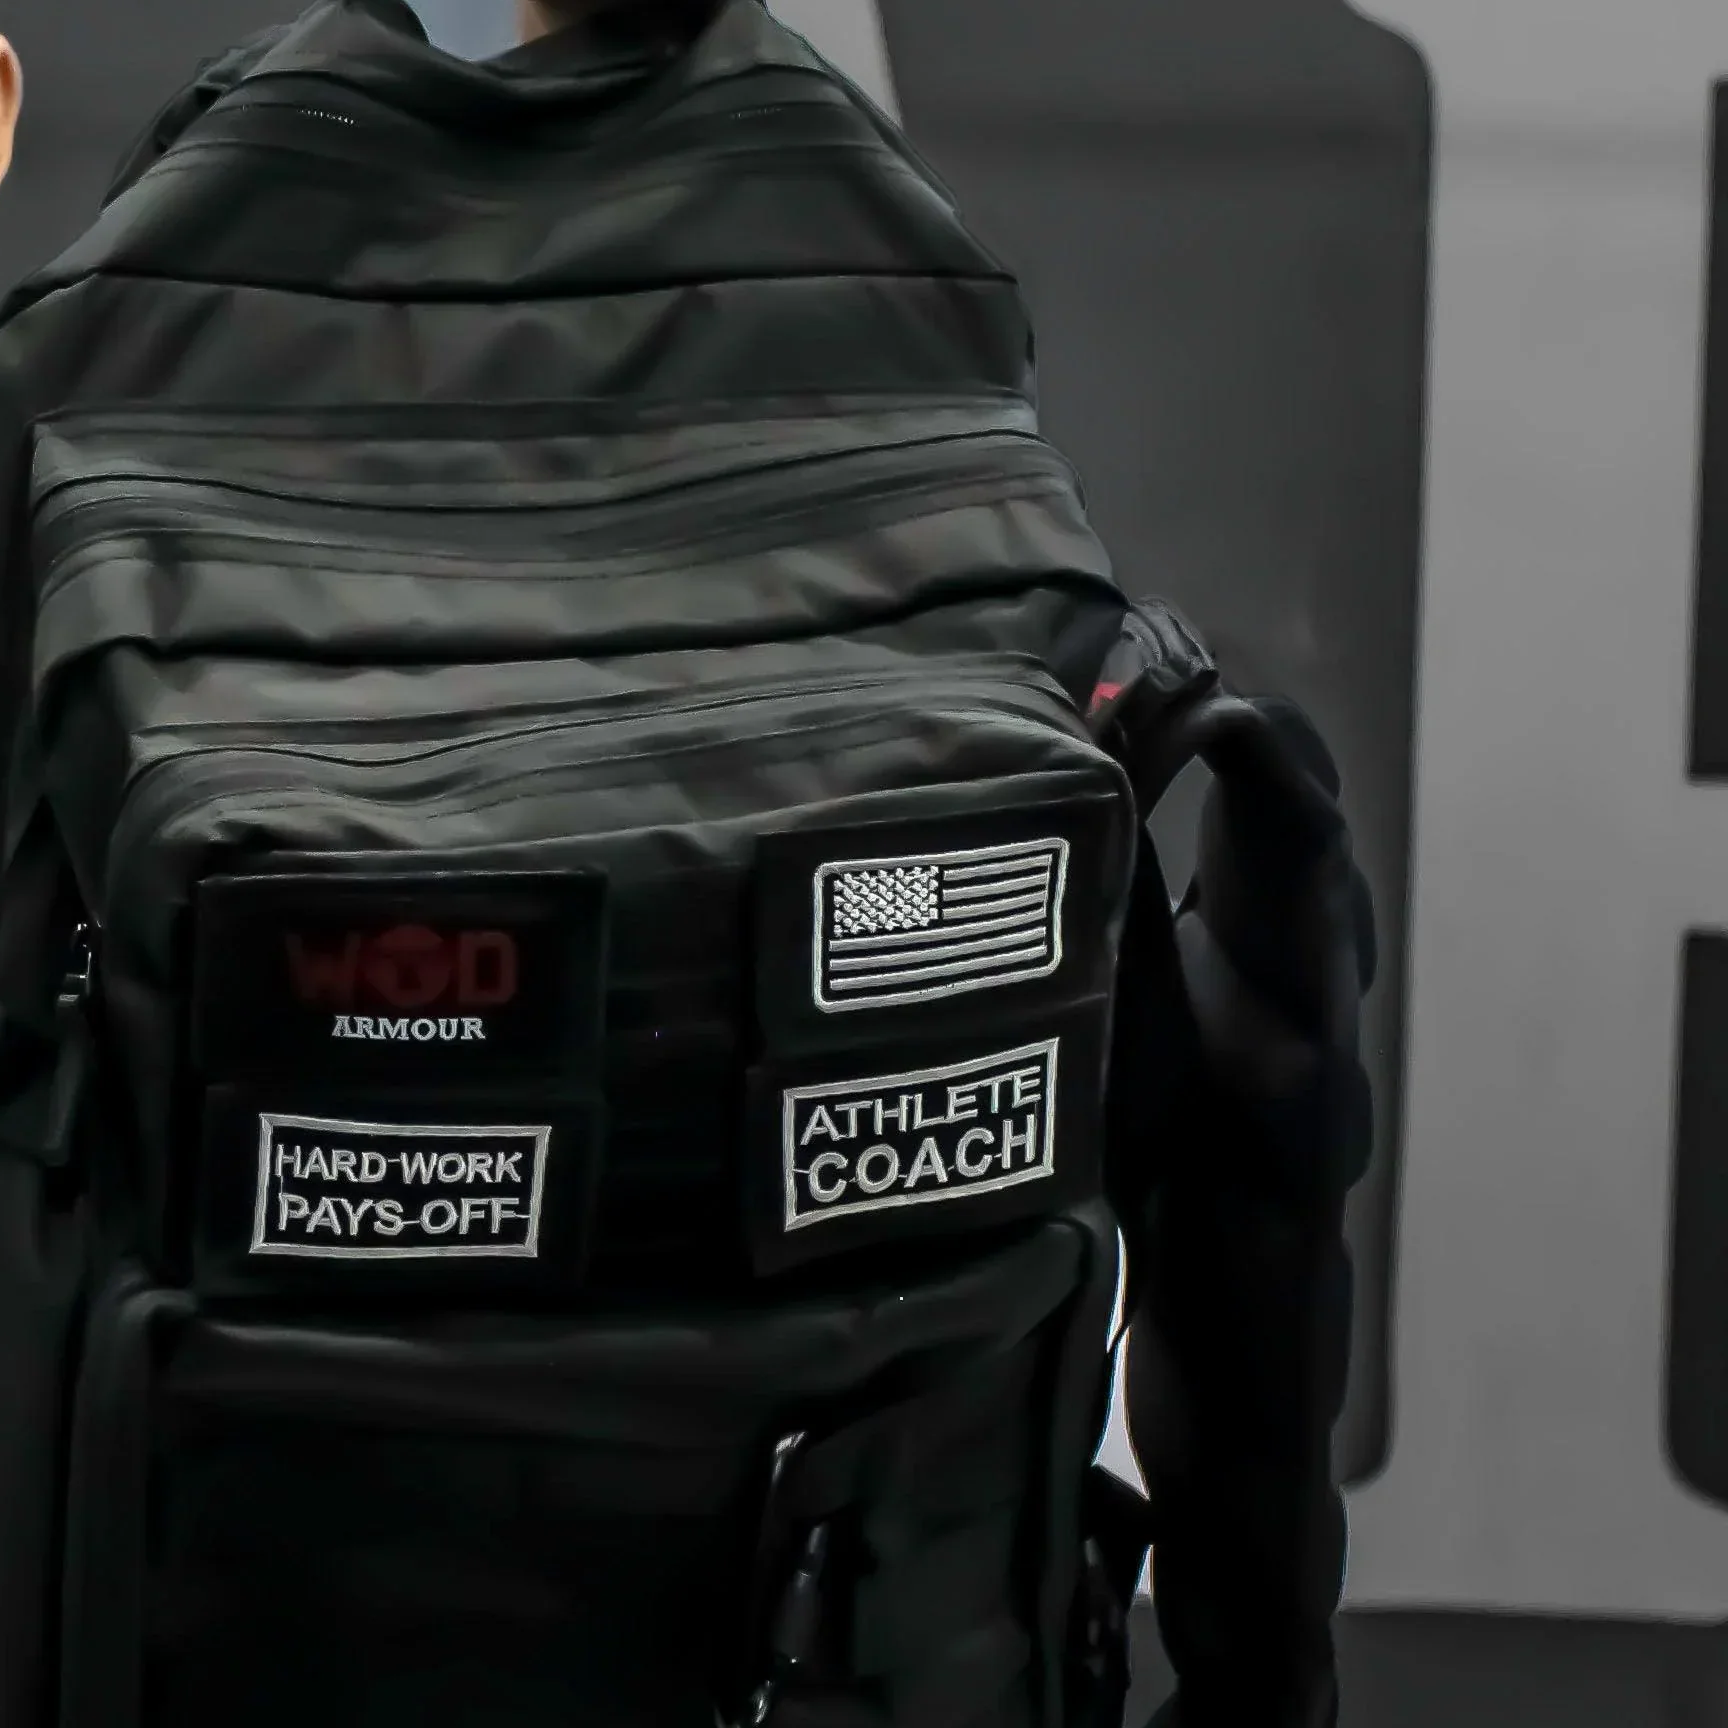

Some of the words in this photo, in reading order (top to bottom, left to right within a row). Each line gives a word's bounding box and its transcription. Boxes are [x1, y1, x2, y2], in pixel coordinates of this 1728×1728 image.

[331, 1014, 488, 1042] ARMOUR
[799, 1065, 1042, 1146] ATHLETE
[275, 1143, 388, 1183] HARD
[399, 1151, 523, 1185] WORK
[808, 1113, 1036, 1203] COACH
[278, 1192, 404, 1236] PAYS
[421, 1197, 520, 1235] OFF
